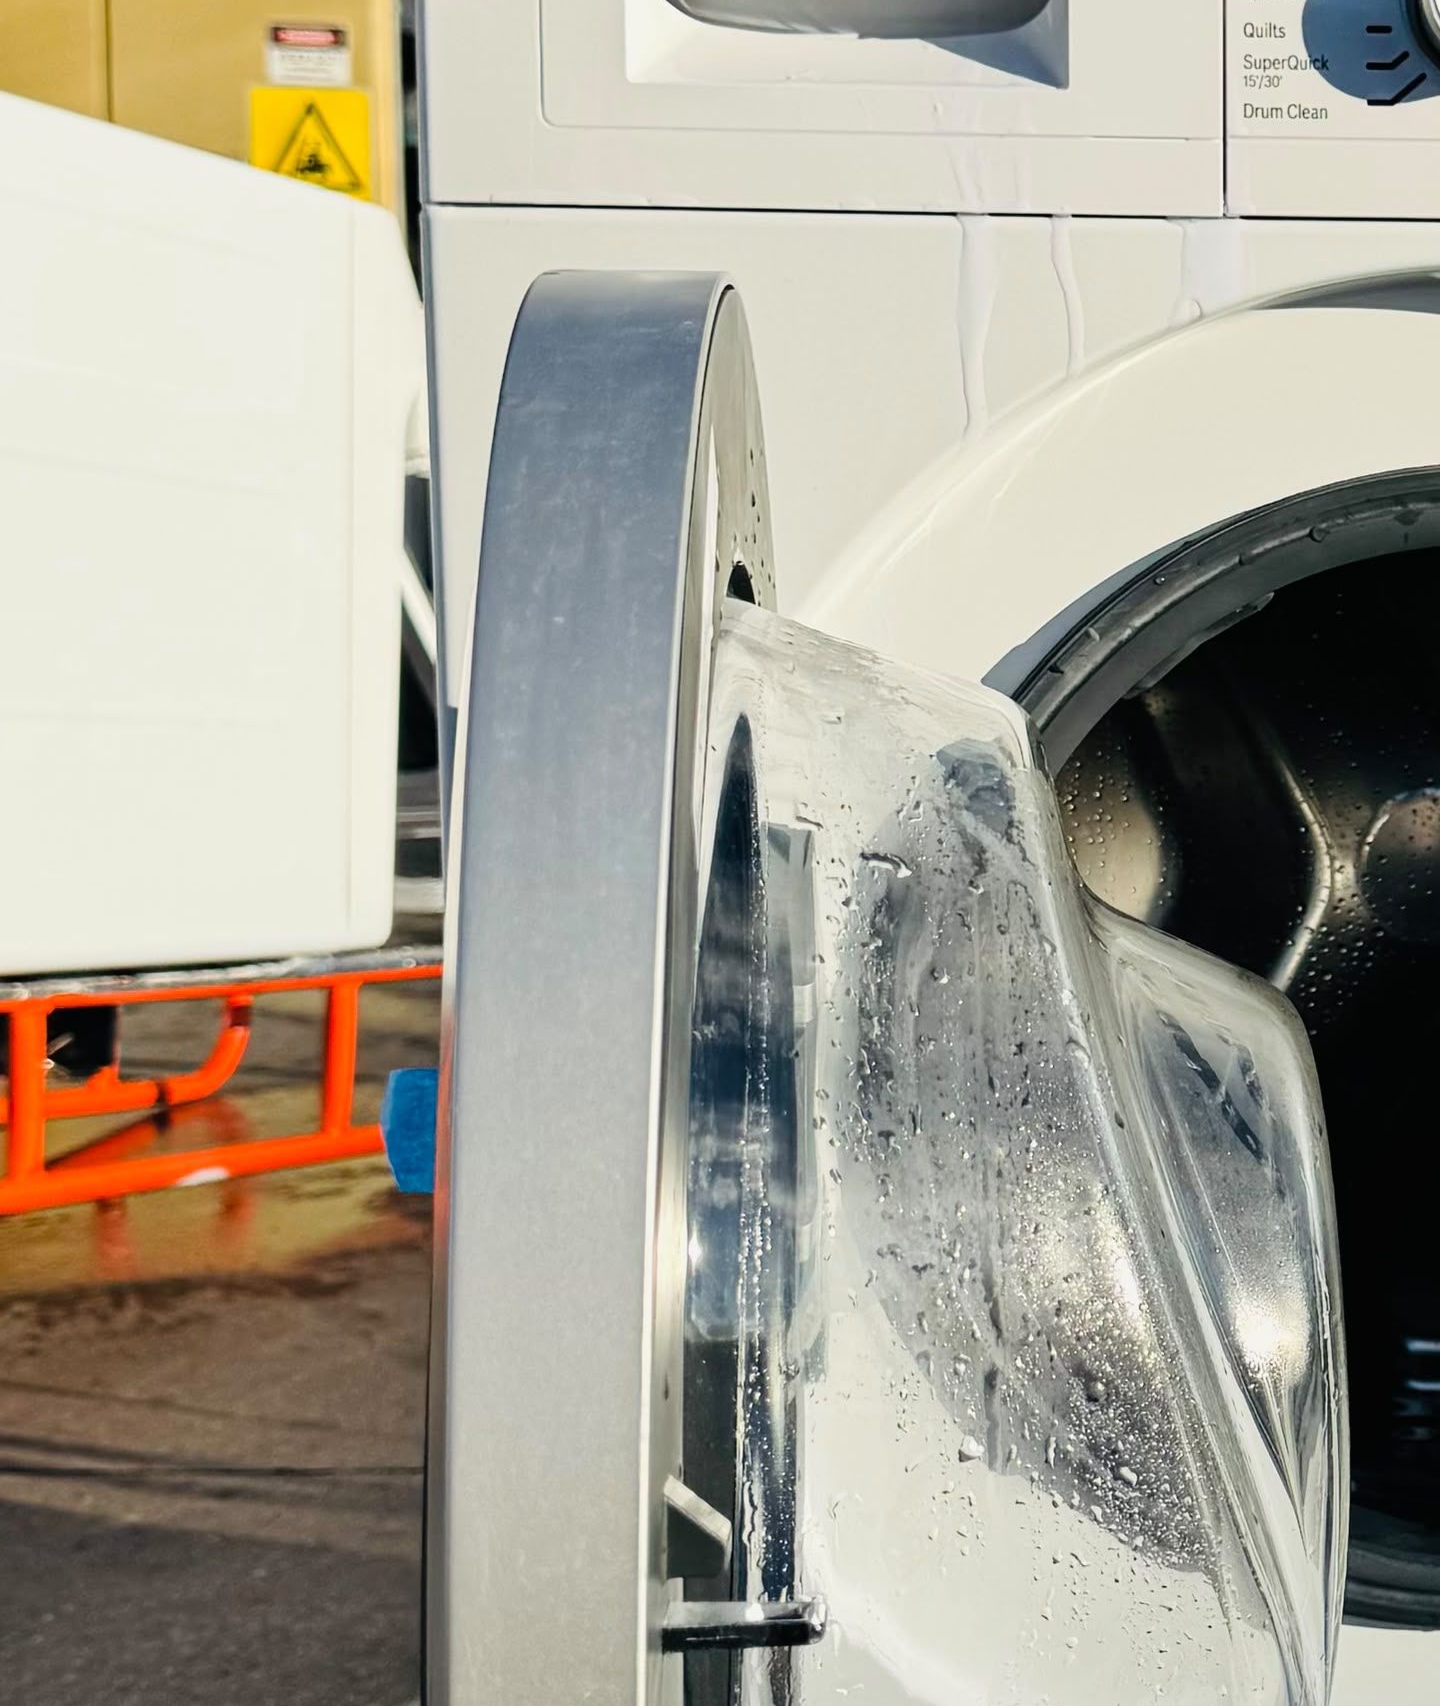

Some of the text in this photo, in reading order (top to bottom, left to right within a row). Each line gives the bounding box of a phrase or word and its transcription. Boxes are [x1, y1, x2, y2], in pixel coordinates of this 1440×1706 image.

[1242, 22, 1287, 39] Quilts
[1242, 54, 1329, 75] SuperQuick
[1242, 103, 1329, 120] Drum Clean
